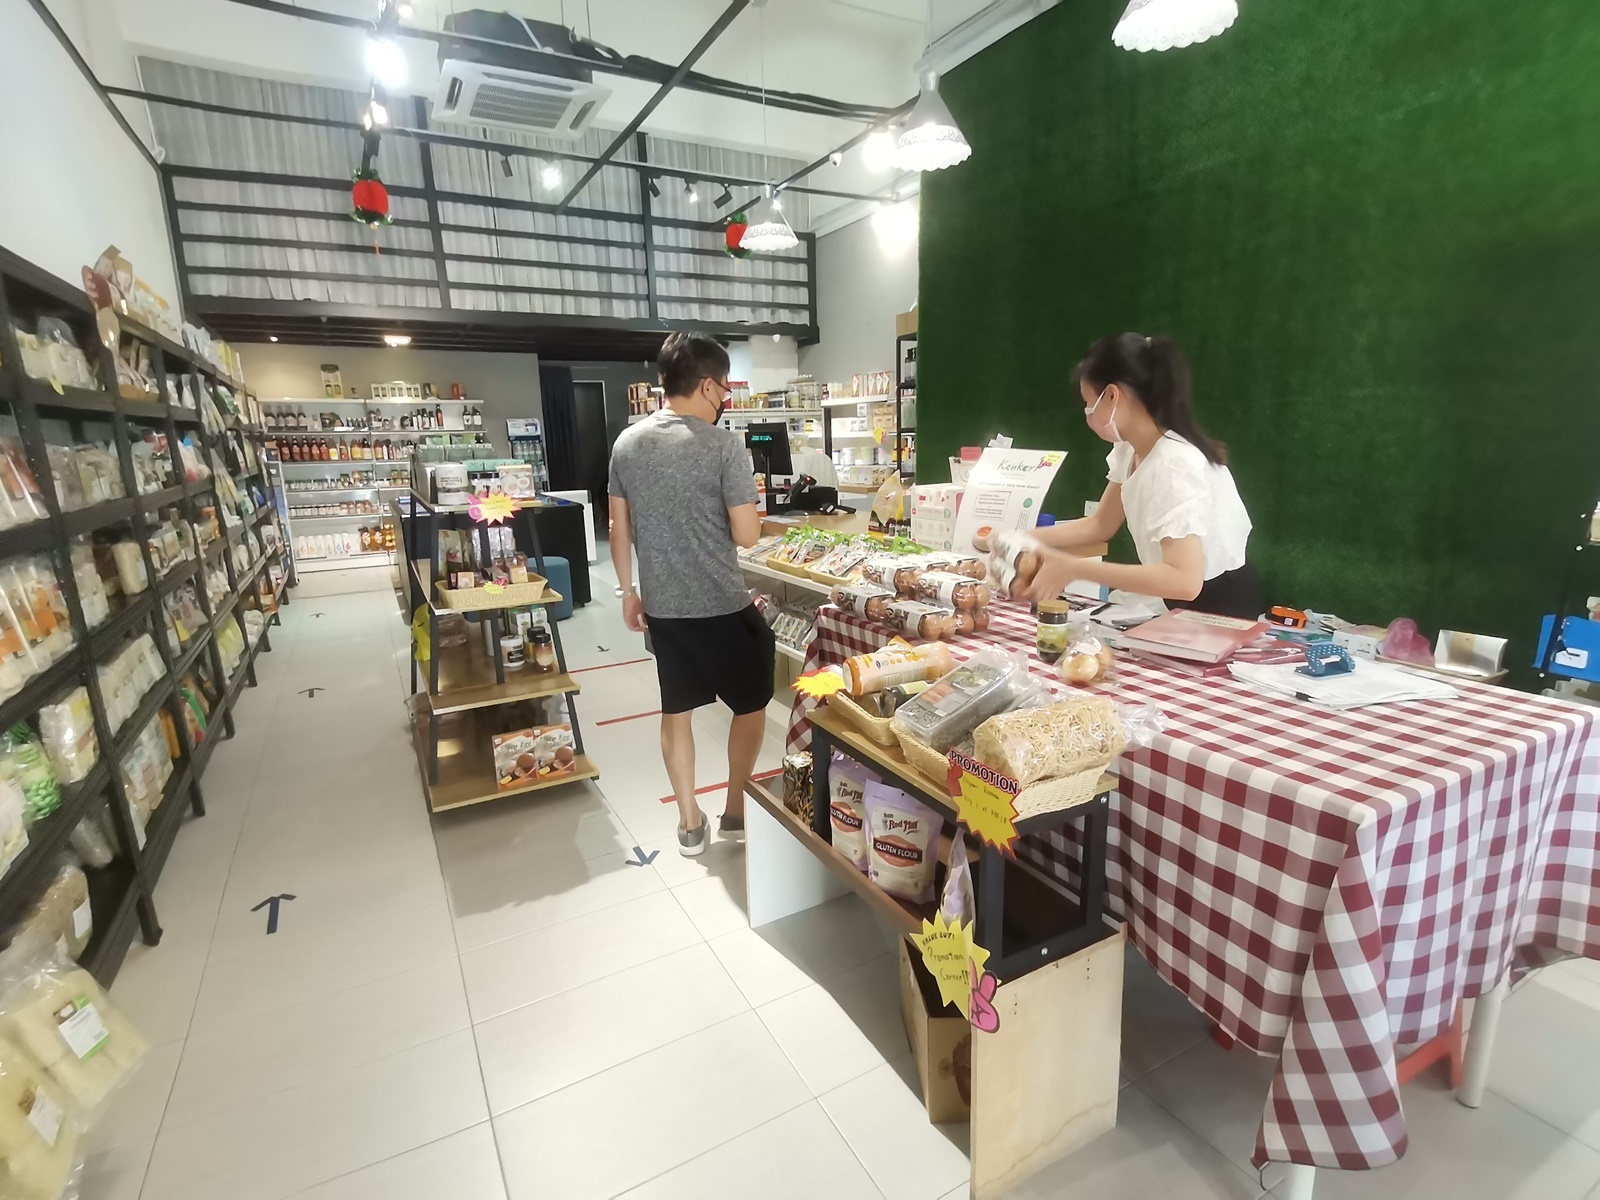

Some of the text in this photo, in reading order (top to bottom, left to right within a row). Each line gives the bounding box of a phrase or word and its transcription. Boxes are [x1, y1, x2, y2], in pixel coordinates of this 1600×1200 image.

[951, 749, 1018, 795] PROMOTION
[842, 815, 859, 827] FLOUR
[888, 819, 918, 832] Red Mill
[875, 842, 918, 859] GLUTEN FLOUR
